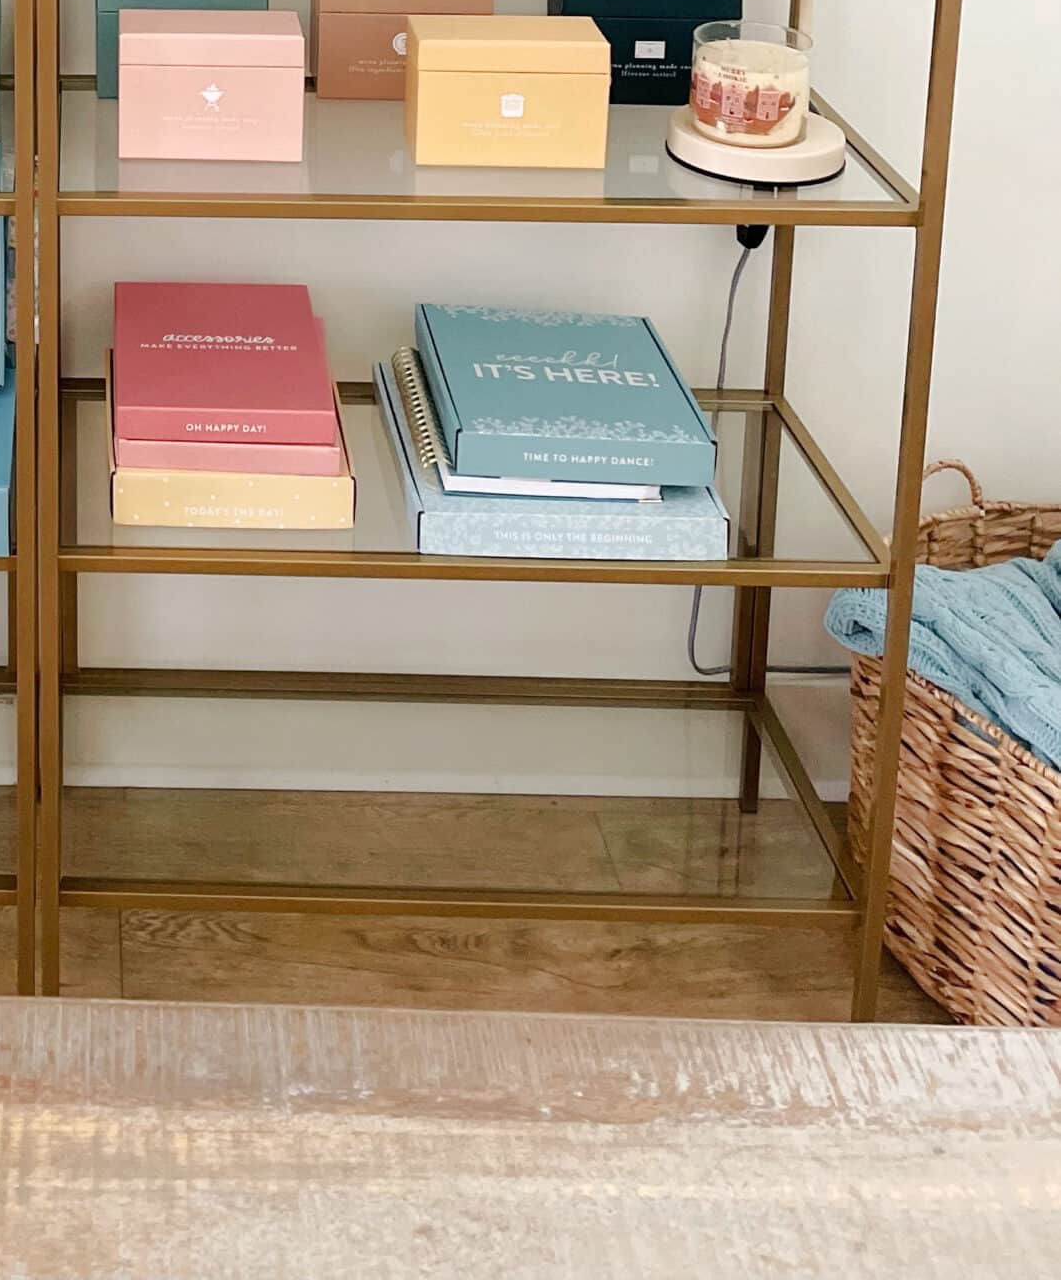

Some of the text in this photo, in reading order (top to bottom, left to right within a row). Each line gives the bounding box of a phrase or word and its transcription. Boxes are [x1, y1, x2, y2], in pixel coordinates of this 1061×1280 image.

[162, 333, 276, 344] accessories
[177, 343, 252, 351] EVERYTHING
[472, 363, 661, 389] IT'S HERE!
[185, 423, 268, 434] OH HAPPY DAY!
[522, 452, 655, 467] TIME TO HAPPY DANCE!
[493, 530, 654, 545] THIS IS ONLY THE BEGINNING
